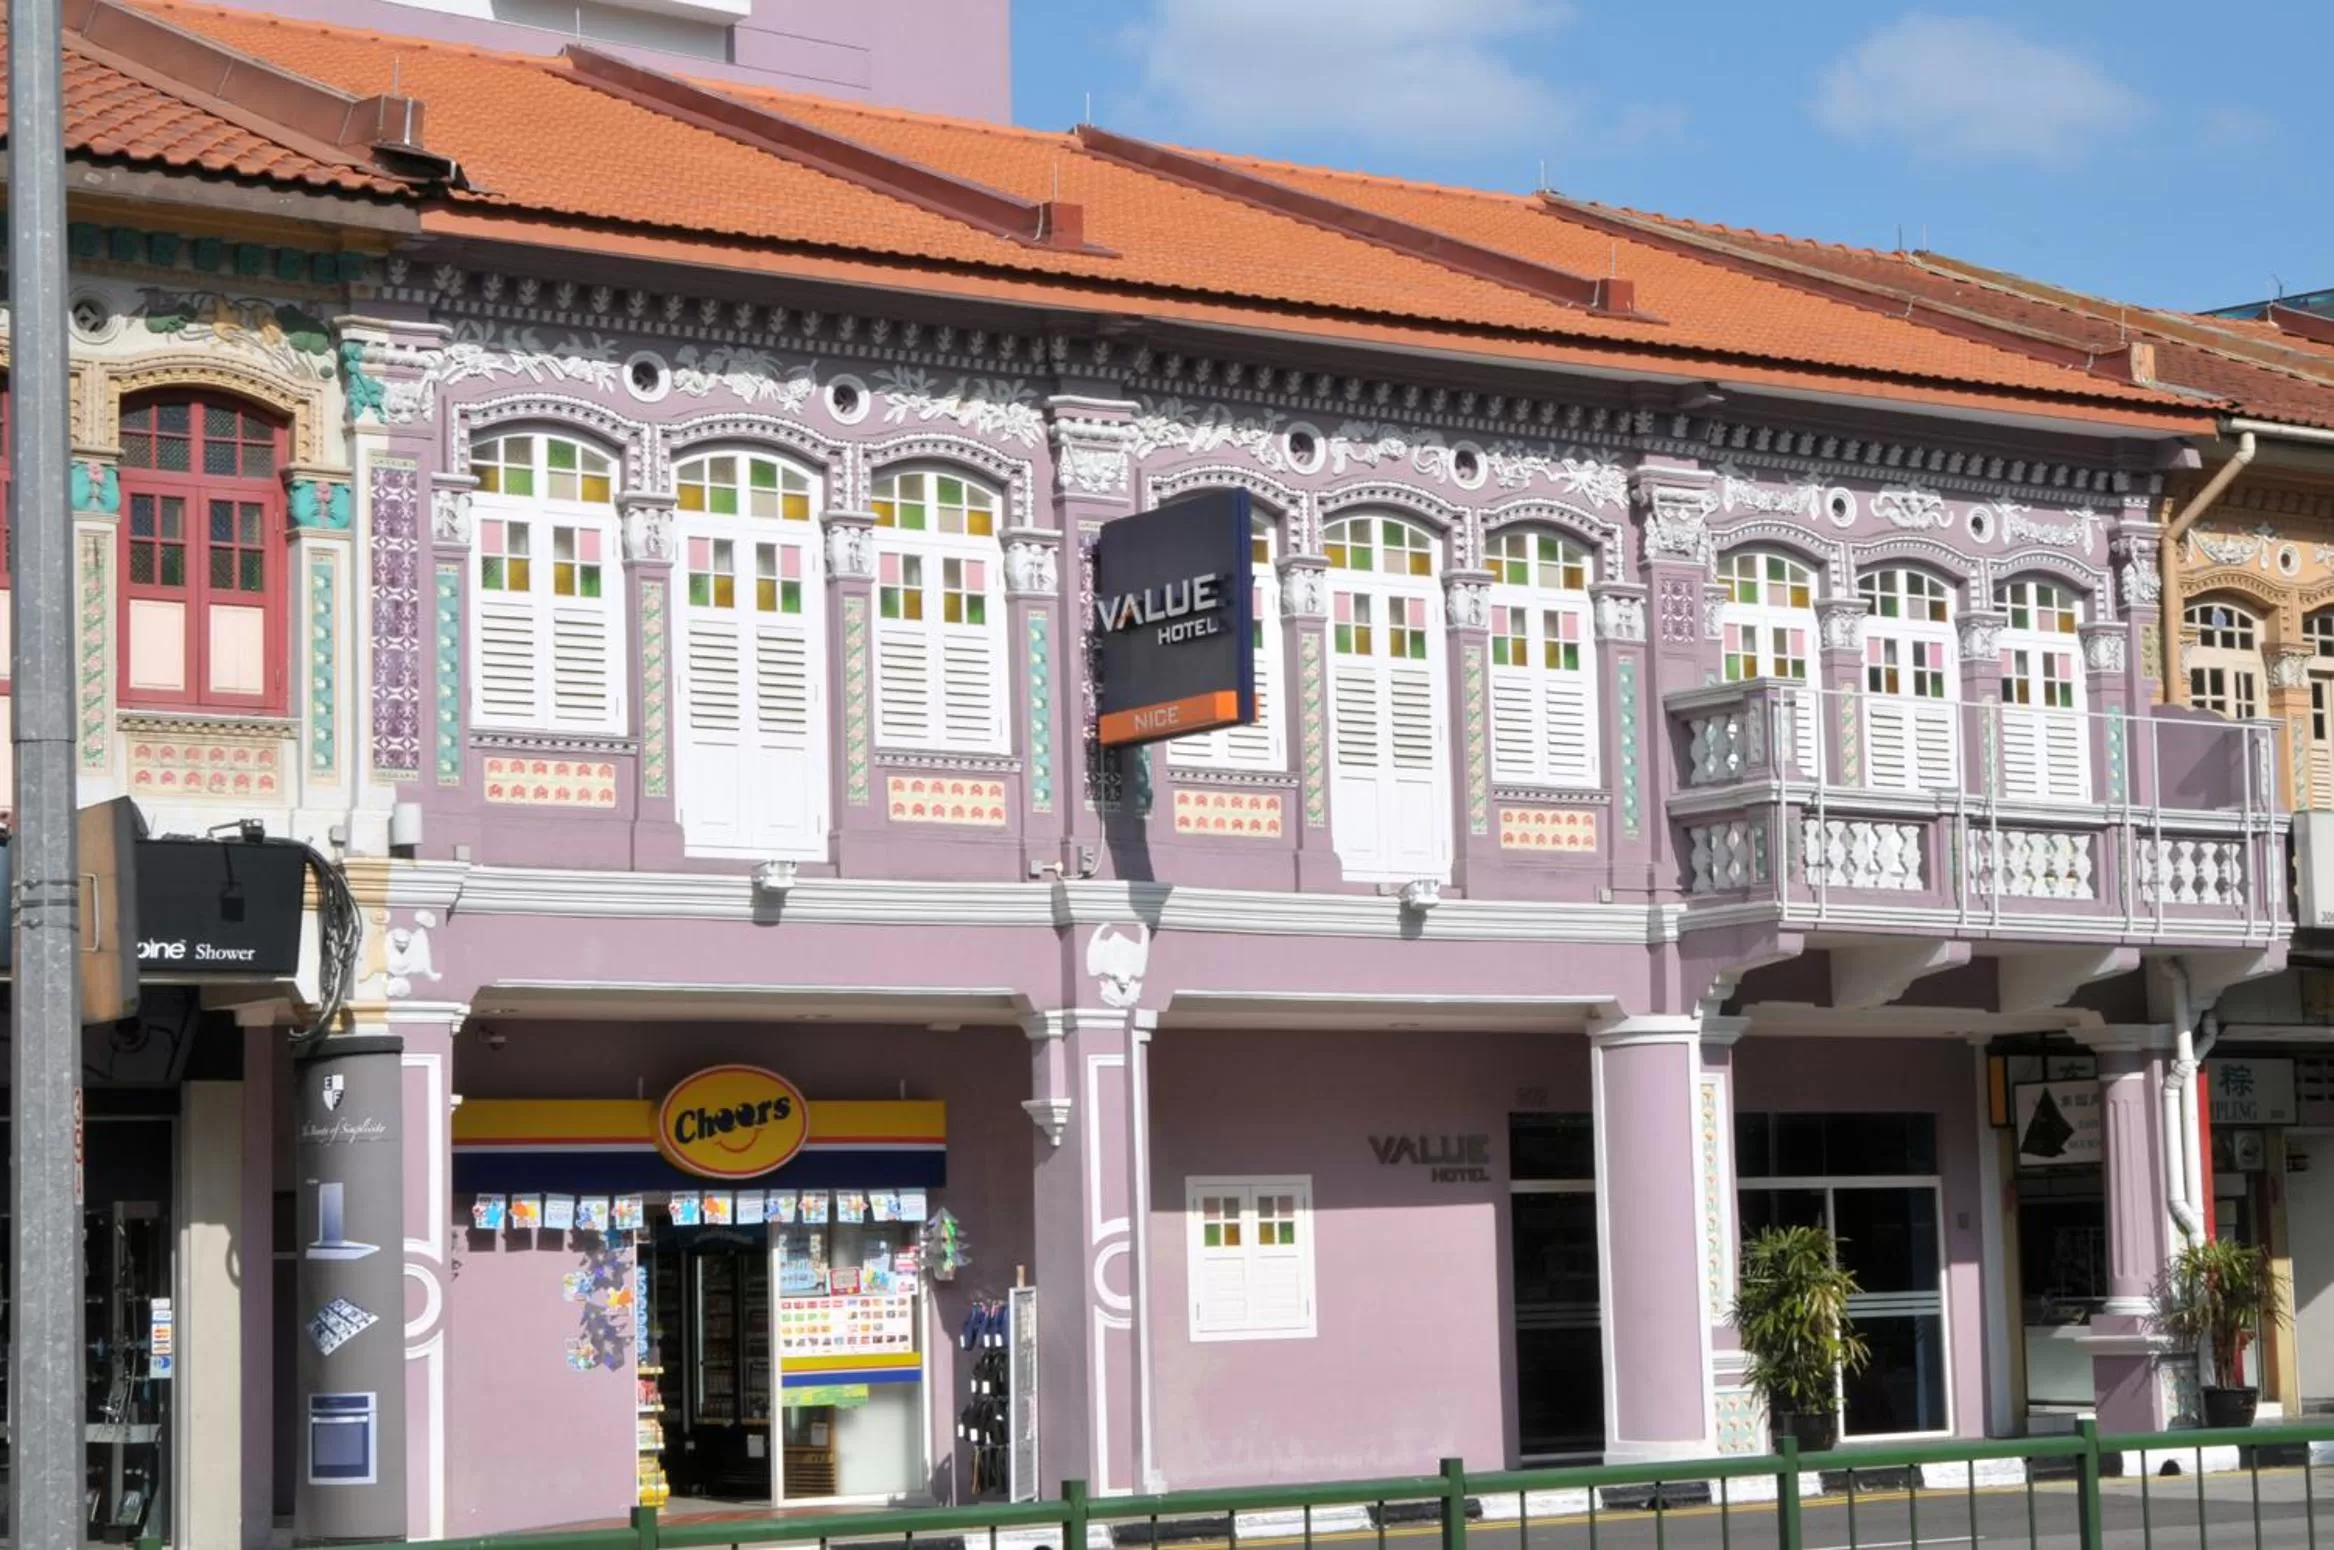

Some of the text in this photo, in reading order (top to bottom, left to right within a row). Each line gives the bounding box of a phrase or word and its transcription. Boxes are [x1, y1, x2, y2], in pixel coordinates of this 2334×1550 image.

[1096, 573, 1217, 633] VALUE
[1157, 617, 1218, 645] HOTEL
[1134, 705, 1179, 731] NICE
[194, 943, 256, 961] Shower
[674, 1096, 792, 1144] Cheers
[1367, 1133, 1491, 1165] VALUE
[1431, 1167, 1492, 1184] HOTEL
